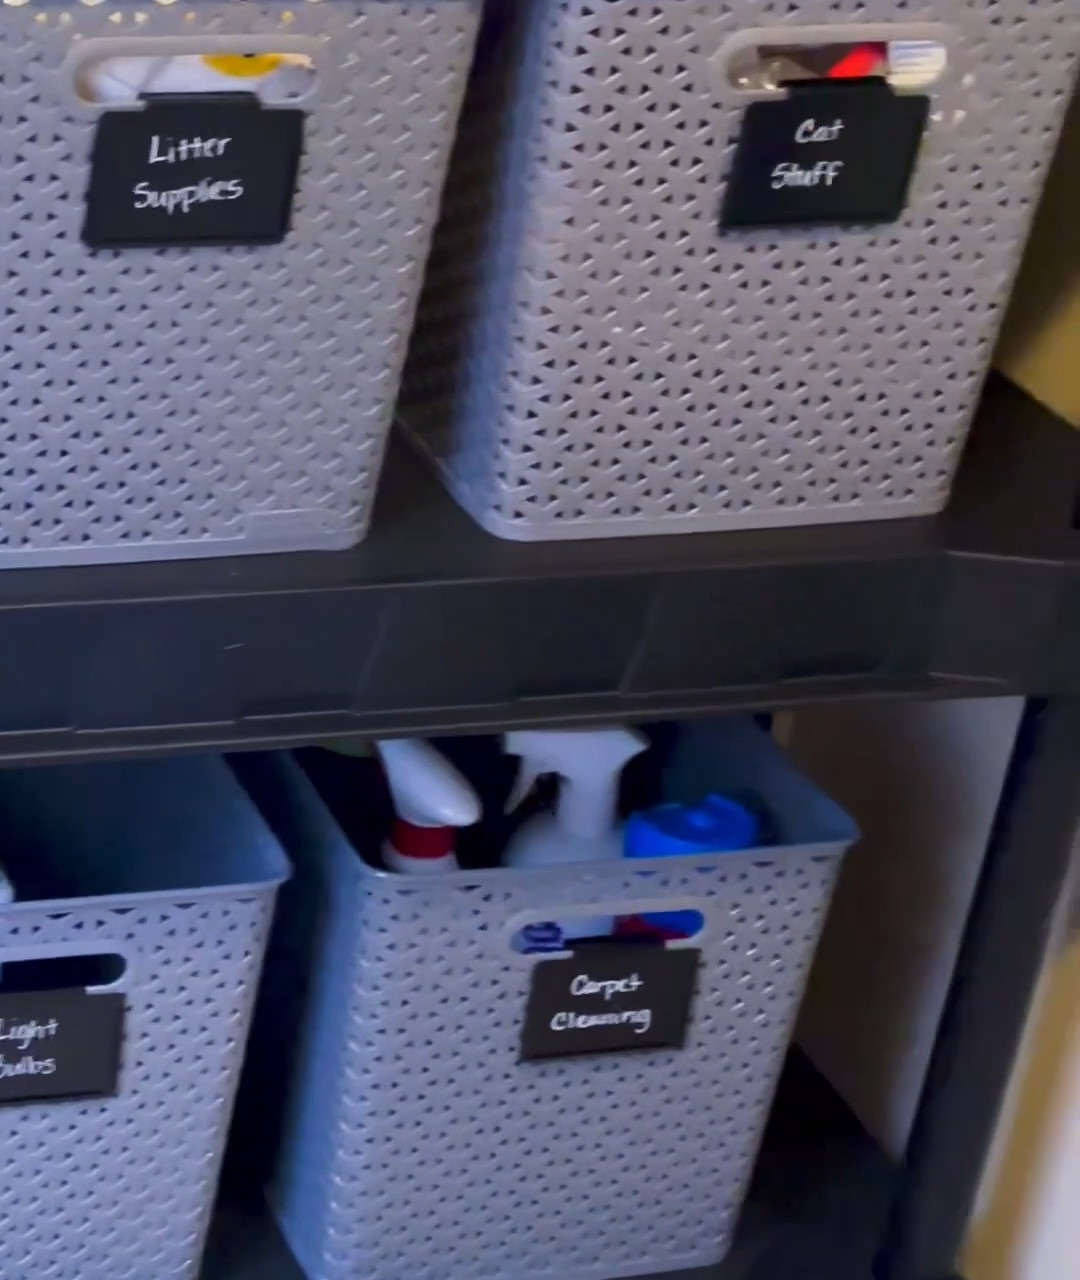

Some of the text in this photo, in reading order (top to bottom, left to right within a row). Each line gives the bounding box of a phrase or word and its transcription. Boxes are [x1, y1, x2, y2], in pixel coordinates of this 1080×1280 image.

[795, 119, 845, 144] Cat
[148, 134, 232, 164] Litter
[771, 161, 844, 189] Stuff
[133, 177, 244, 215] Supplies
[571, 973, 644, 1001] Carpet
[550, 1009, 652, 1034] Cleaning
